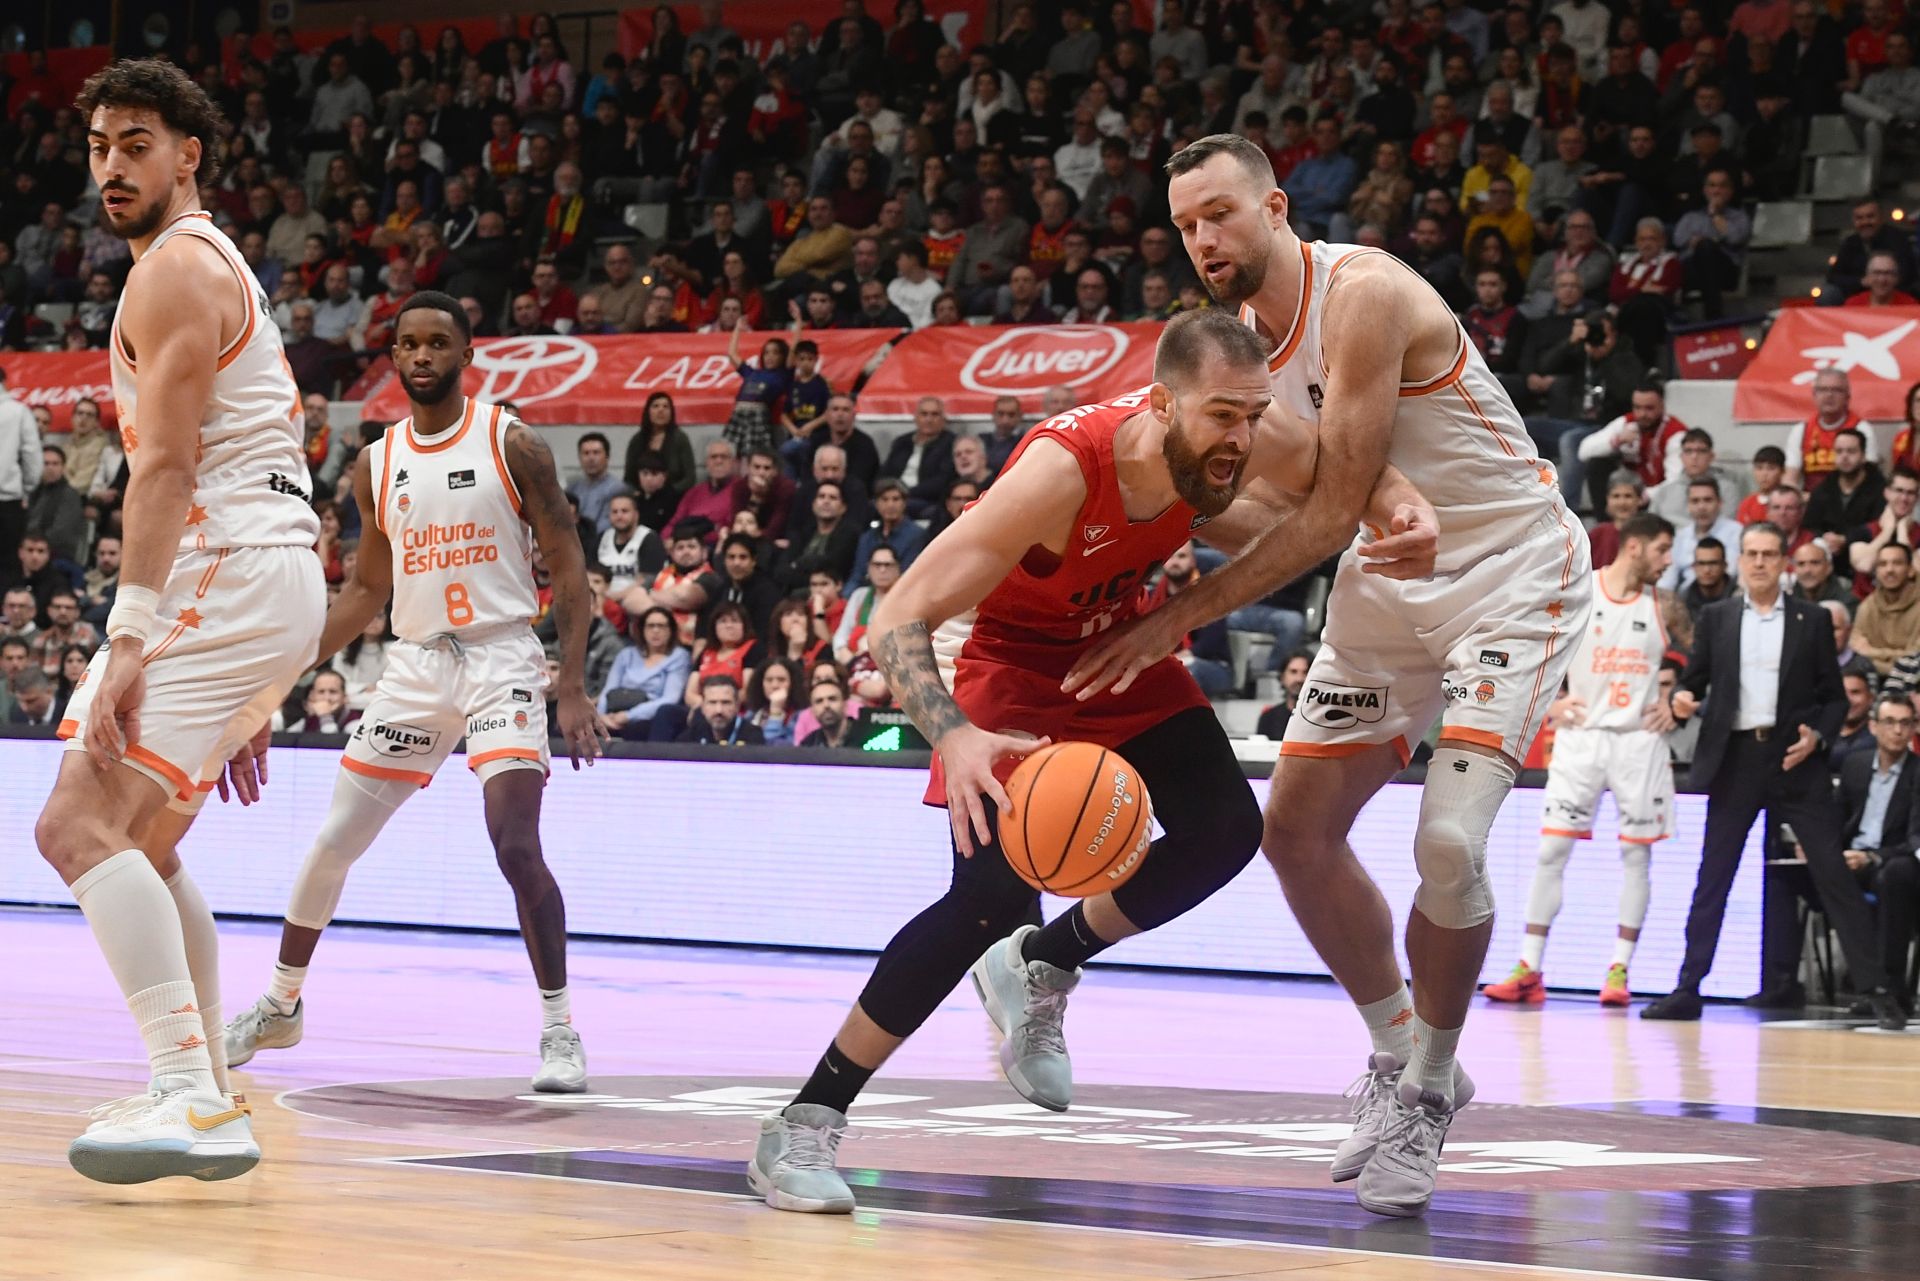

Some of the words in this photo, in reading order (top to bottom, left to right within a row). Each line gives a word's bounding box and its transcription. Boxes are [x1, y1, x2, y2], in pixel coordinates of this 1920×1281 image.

[978, 348, 1108, 377] Juver
[403, 522, 476, 550] Cultura
[477, 525, 496, 539] del
[403, 544, 498, 576] Esfuerzo
[445, 582, 474, 627] 8
[1481, 654, 1502, 666] acb
[1306, 687, 1380, 709] PULEVA
[1608, 681, 1632, 708] 16
[374, 725, 431, 747] PULEVA
[514, 1094, 1564, 1174] UNIERSIDD
